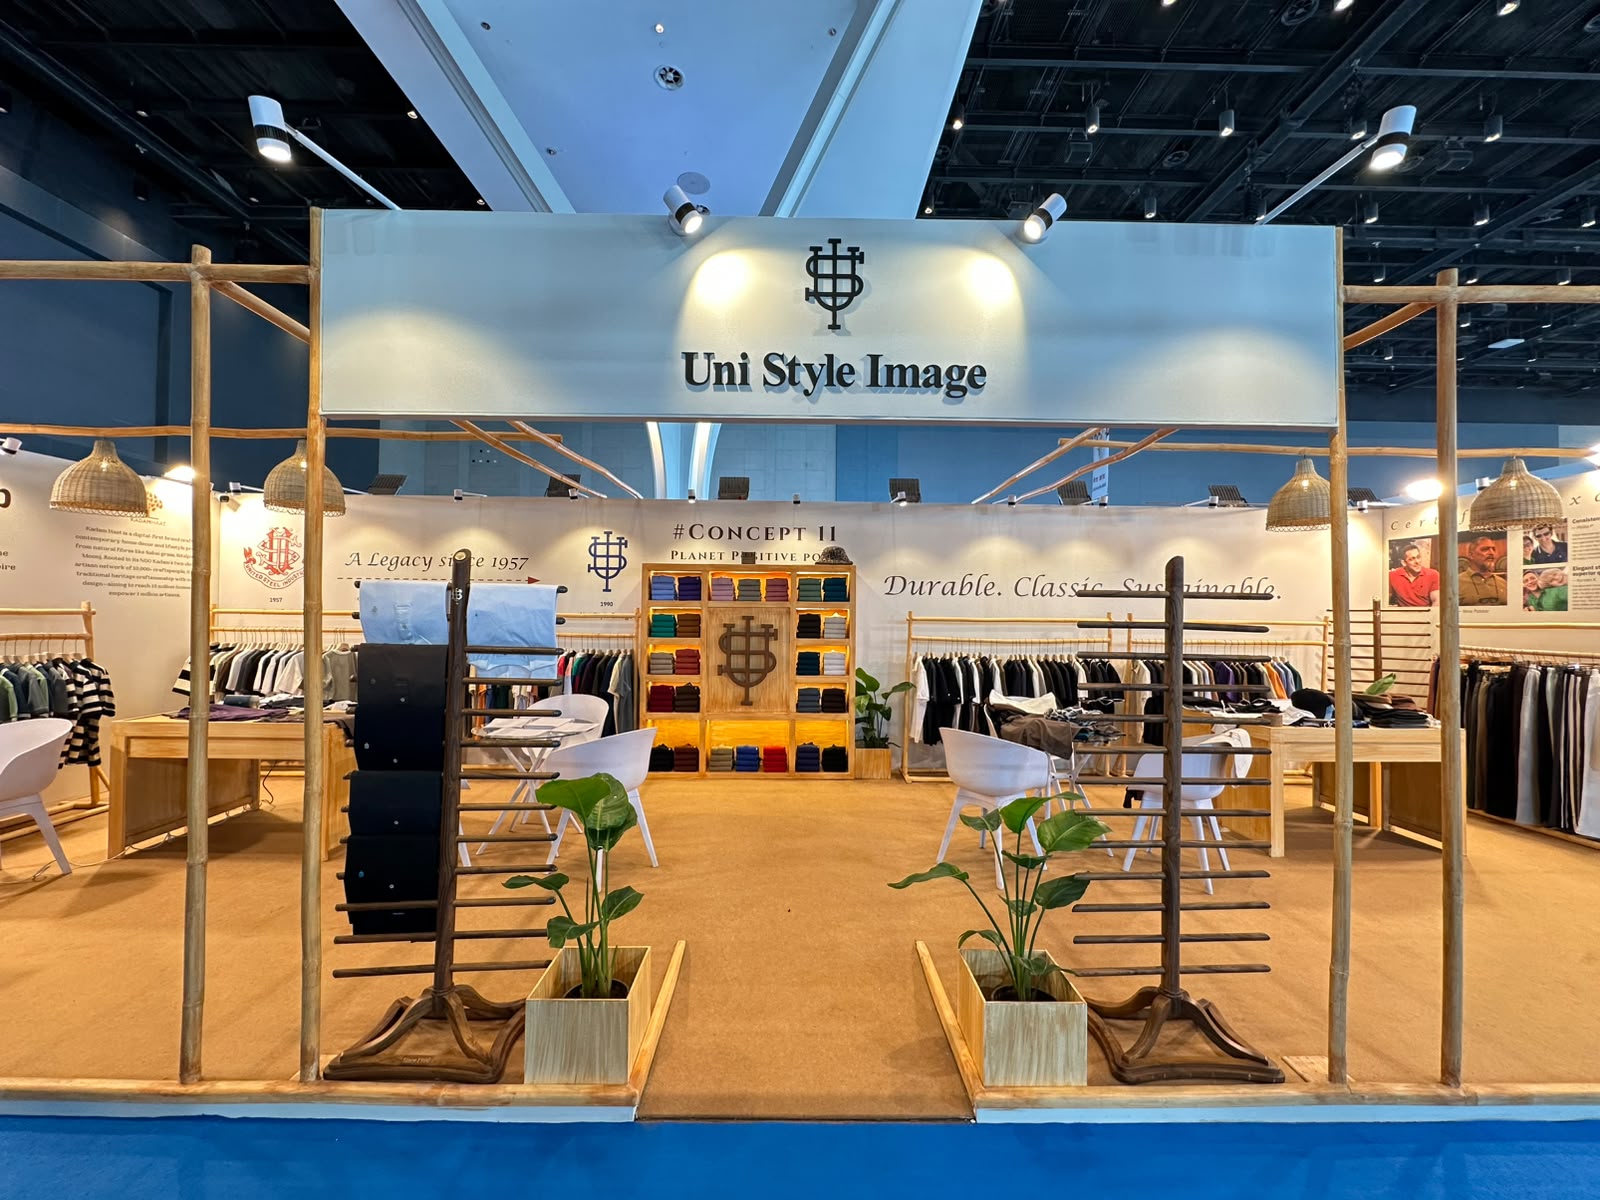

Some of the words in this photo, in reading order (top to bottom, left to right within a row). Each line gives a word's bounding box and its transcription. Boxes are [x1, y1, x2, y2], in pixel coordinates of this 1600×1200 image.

[681, 352, 750, 386] Uni
[763, 352, 855, 396] Style
[867, 354, 987, 398] Image
[345, 552, 362, 566] A
[368, 552, 433, 572] Legacy
[439, 554, 484, 568] sice
[492, 557, 528, 570] 1957
[671, 550, 725, 560] PLANET
[732, 551, 796, 561] PSITIVE
[804, 553, 822, 562] PO
[245, 564, 263, 580] UNITED
[263, 578, 281, 587] STEEL
[282, 570, 304, 586] INDUSTR
[884, 573, 1002, 596] Durable.
[1124, 576, 1281, 599] Susainable.
